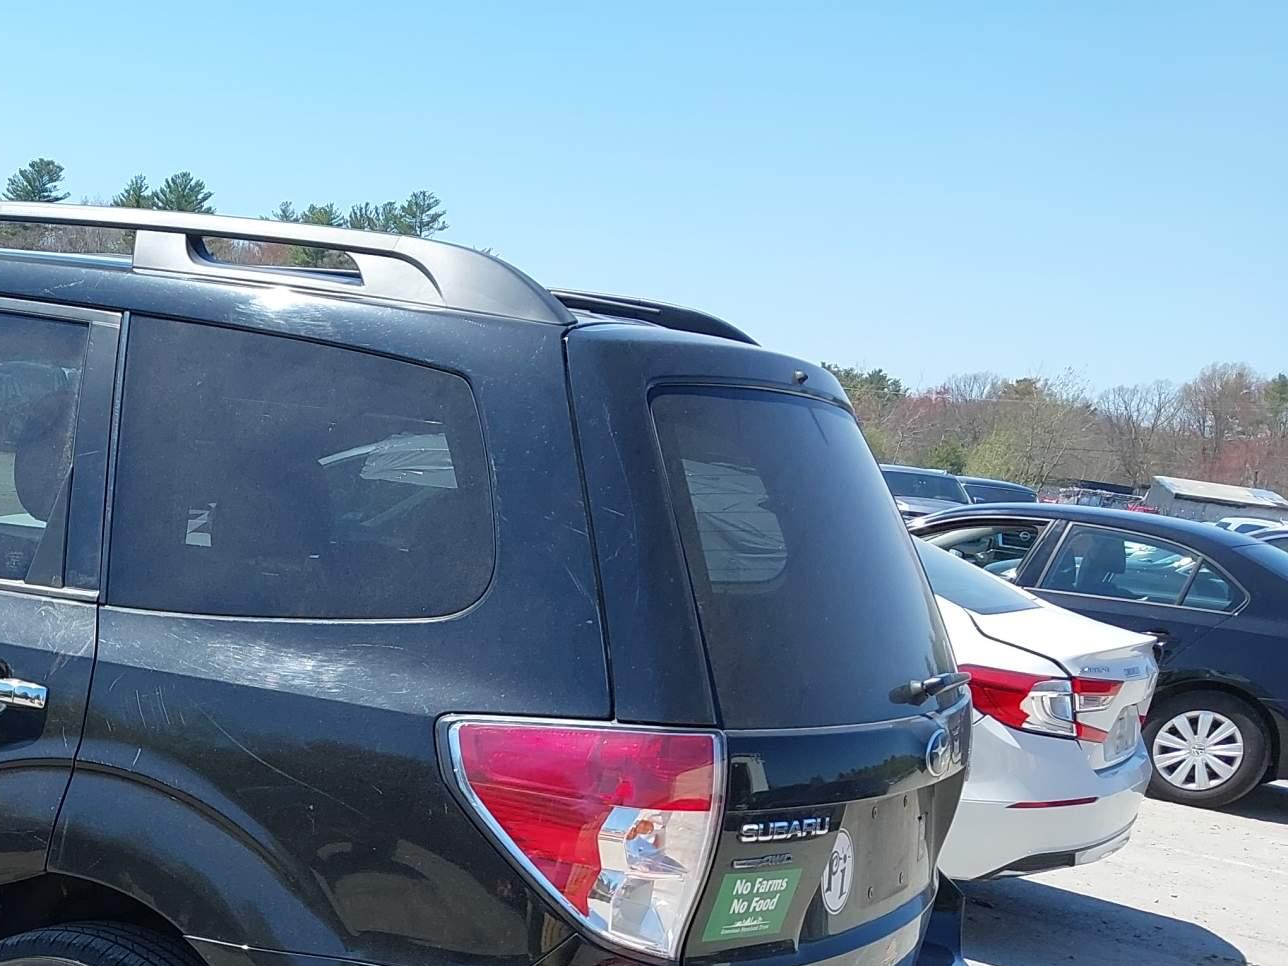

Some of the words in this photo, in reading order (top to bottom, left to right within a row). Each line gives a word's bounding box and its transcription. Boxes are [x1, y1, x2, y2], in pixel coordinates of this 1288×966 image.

[740, 817, 830, 843] SUBARU
[732, 879, 751, 895] No
[753, 877, 788, 894] Farms
[729, 898, 748, 914] No
[749, 893, 780, 913] Food
